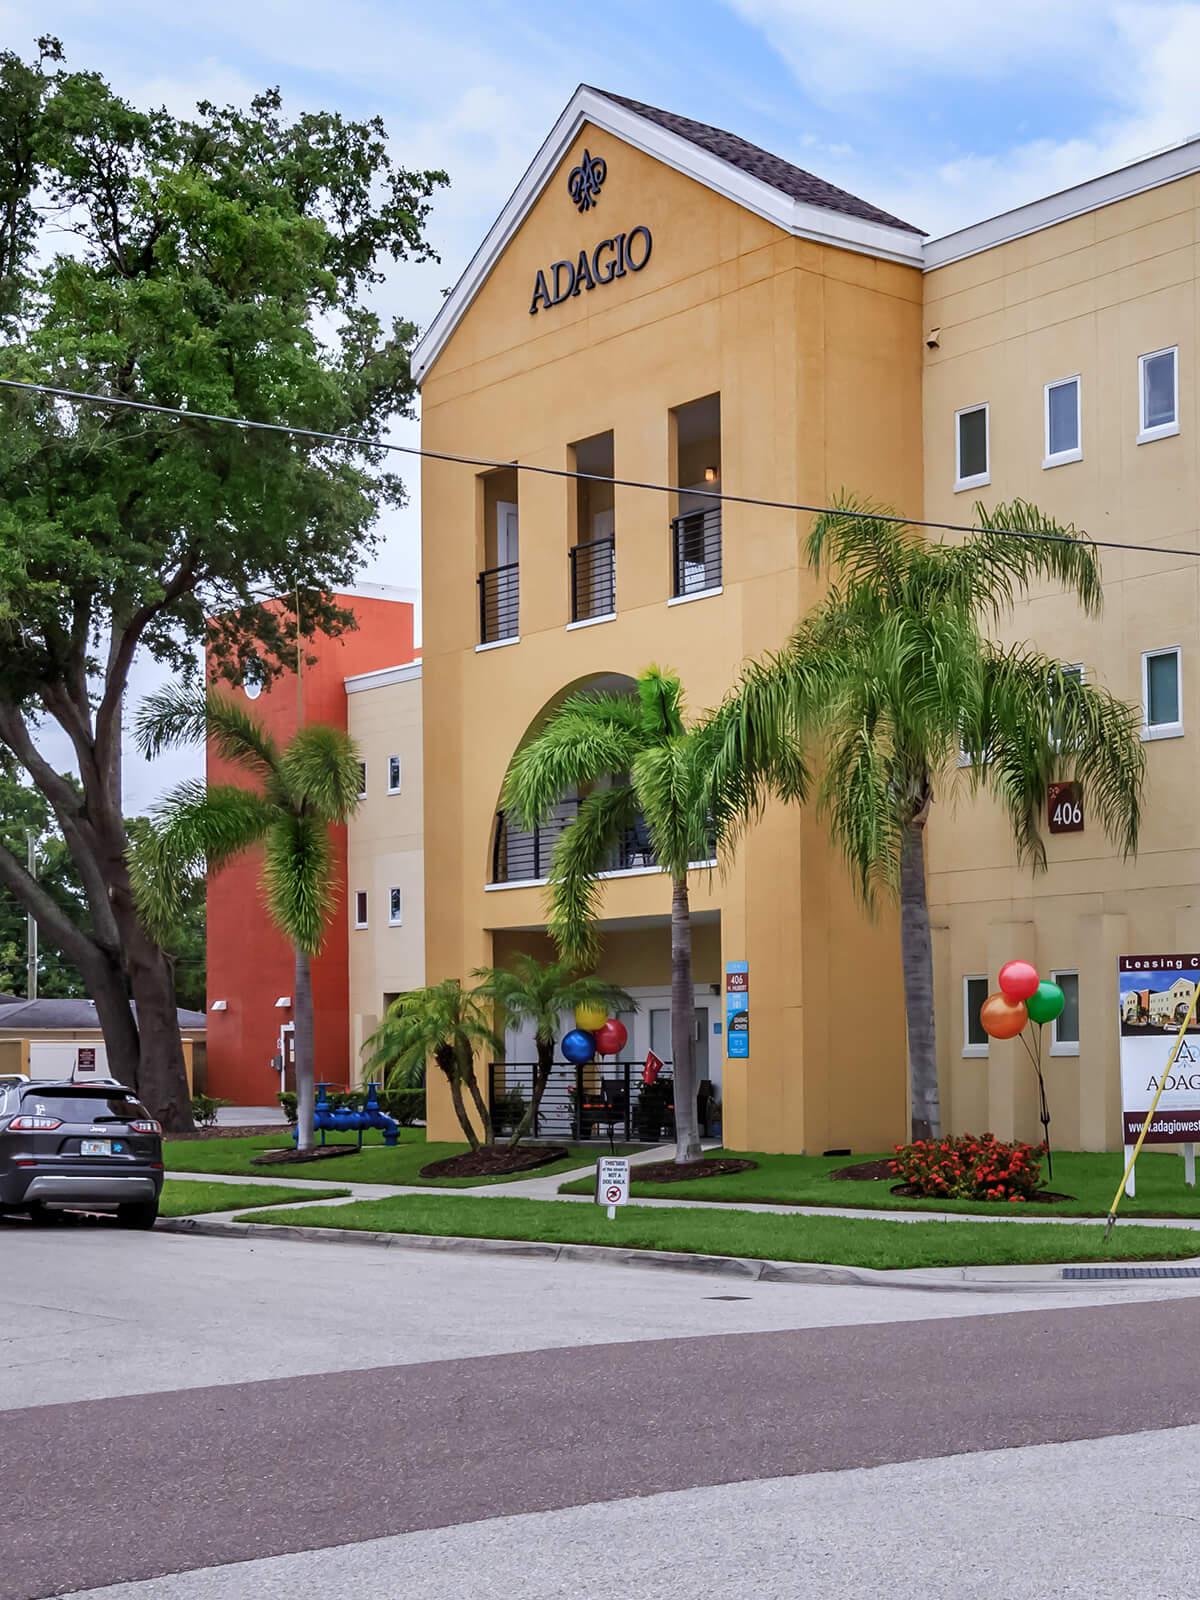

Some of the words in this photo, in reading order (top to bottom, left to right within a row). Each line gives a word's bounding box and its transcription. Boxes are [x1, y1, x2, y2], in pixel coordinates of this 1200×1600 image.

[529, 225, 652, 314] ADAGIO
[1052, 801, 1082, 825] 406
[1125, 958, 1183, 970] Leasing
[730, 975, 743, 984] 406
